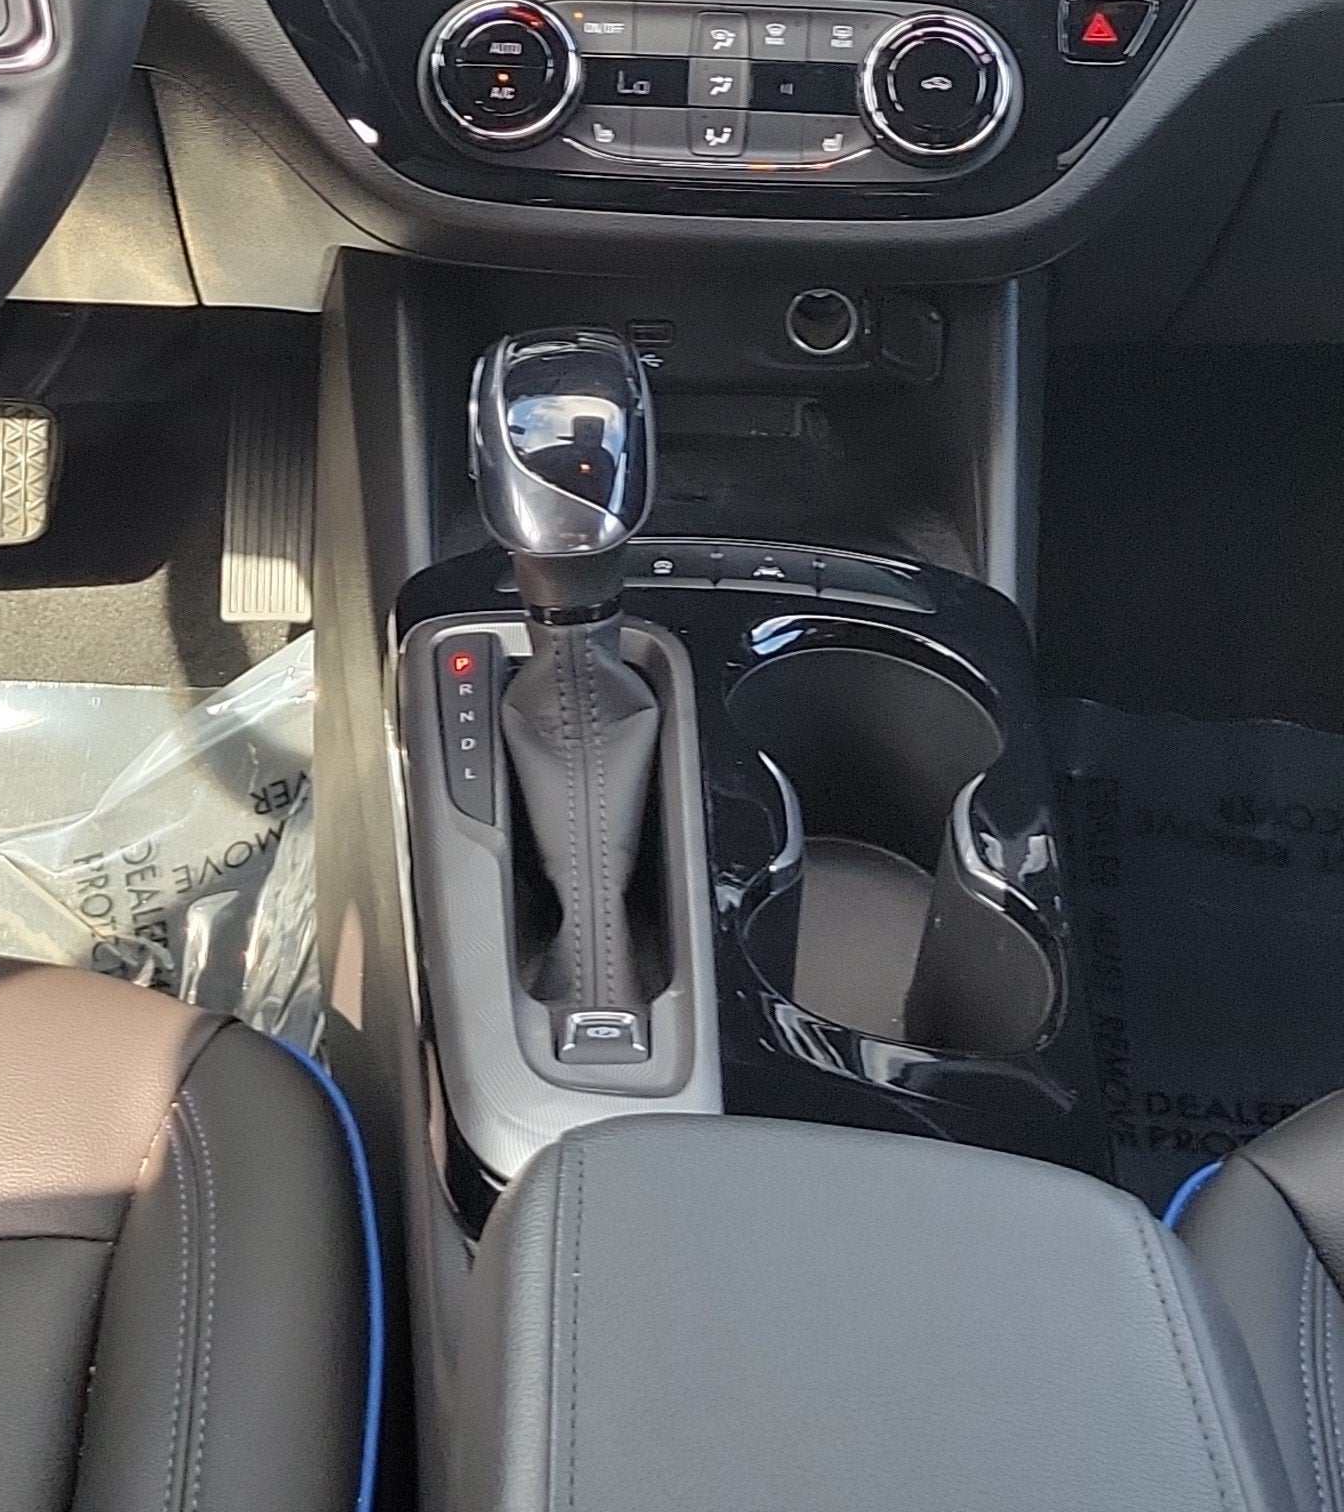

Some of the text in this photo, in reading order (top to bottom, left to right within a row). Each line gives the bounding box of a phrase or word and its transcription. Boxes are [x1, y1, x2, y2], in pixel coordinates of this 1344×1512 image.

[454, 656, 471, 672] P
[459, 683, 473, 696] R
[459, 710, 475, 723] N
[461, 737, 475, 750] D
[464, 768, 477, 779] L
